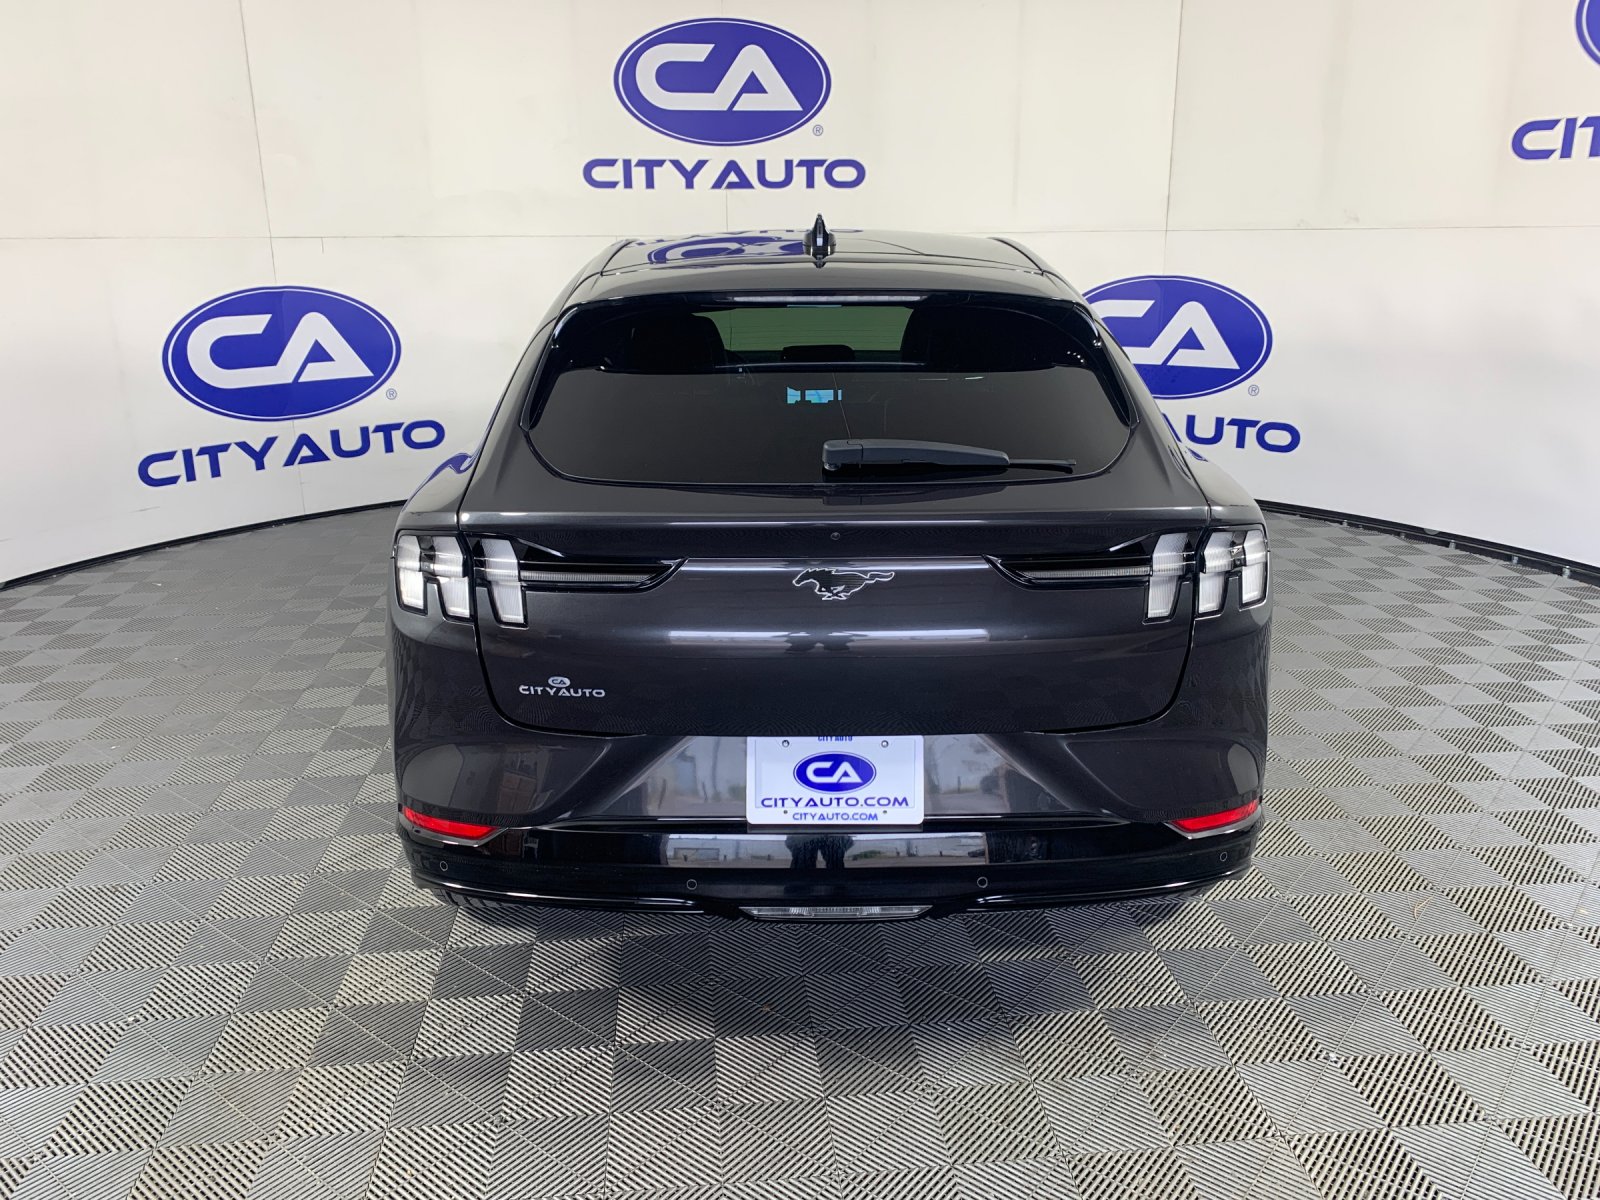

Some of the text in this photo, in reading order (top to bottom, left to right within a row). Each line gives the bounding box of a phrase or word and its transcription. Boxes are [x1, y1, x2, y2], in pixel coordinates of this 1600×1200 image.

[636, 43, 804, 111] CA
[187, 311, 375, 389] CA
[806, 761, 863, 784] CA
